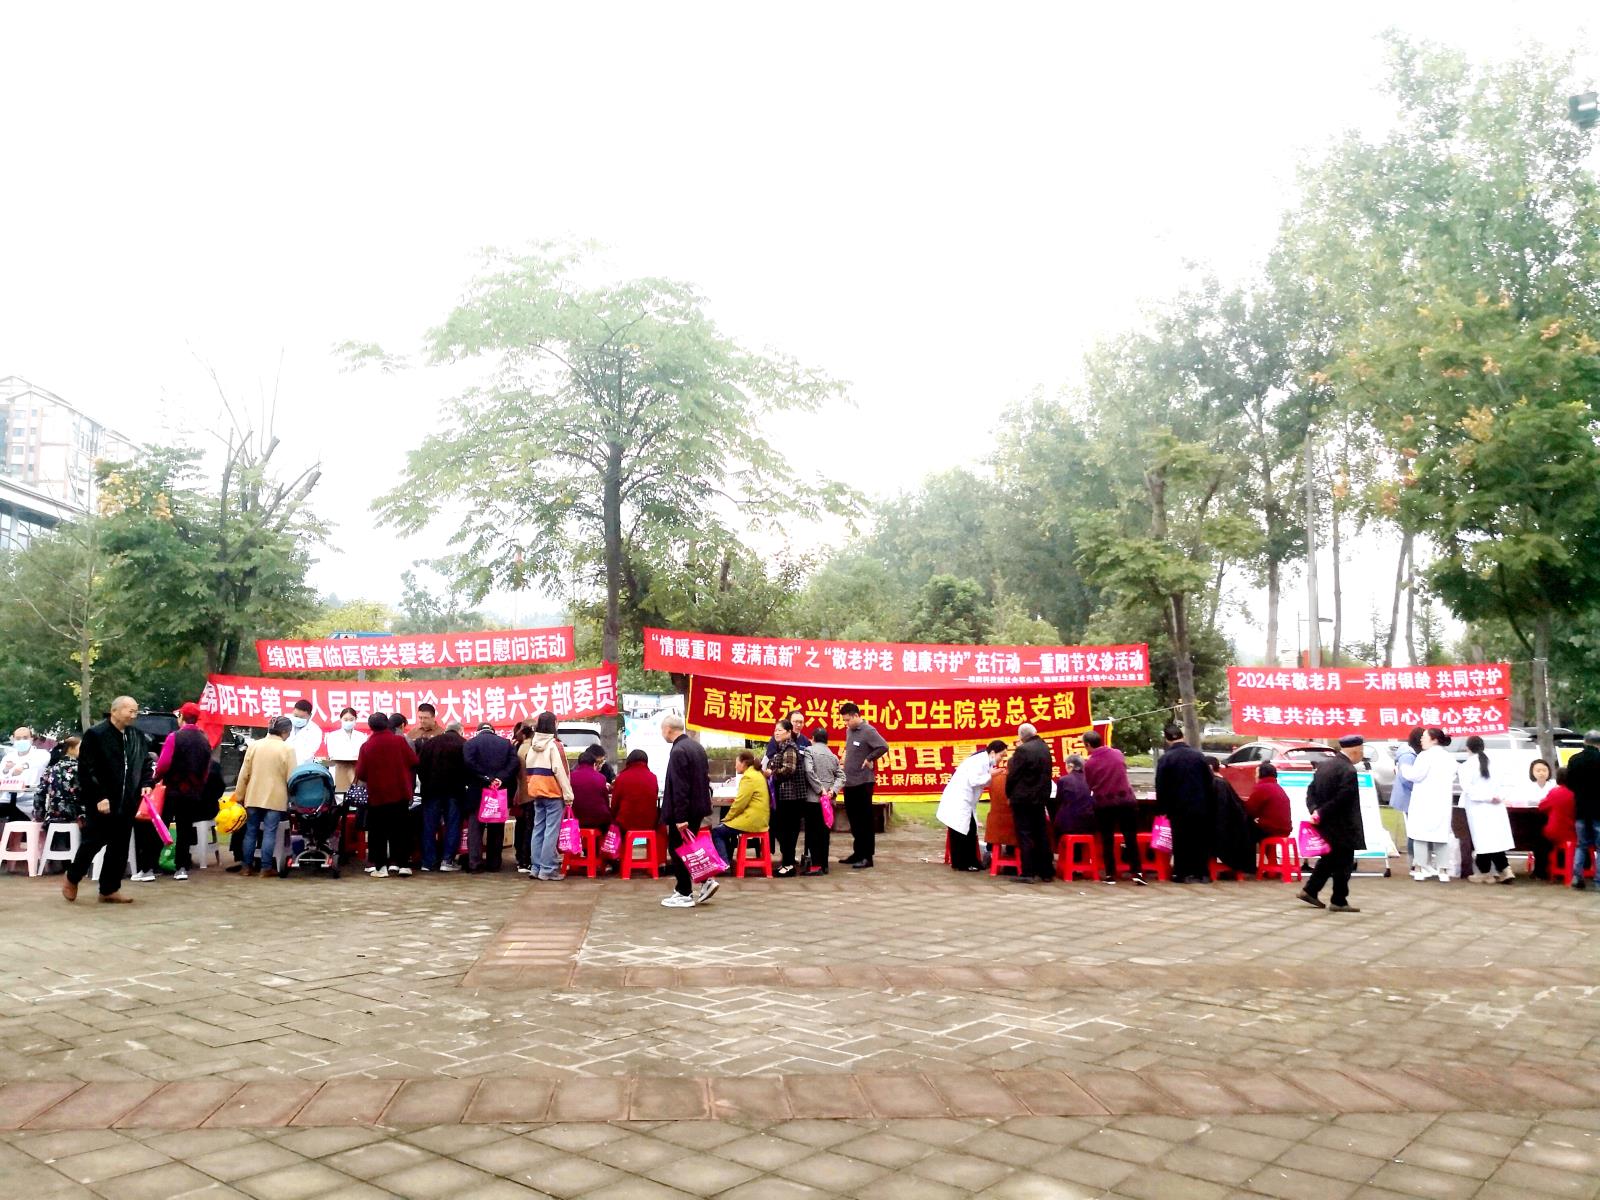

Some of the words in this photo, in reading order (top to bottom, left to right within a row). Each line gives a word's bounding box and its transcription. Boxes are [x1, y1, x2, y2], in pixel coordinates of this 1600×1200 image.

[267, 633, 566, 669] 绵阳富临医院关爱老人节日慰问活动
[1237, 671, 1341, 691] 2024年敬老月
[1436, 668, 1503, 689] 共同守护
[200, 674, 619, 725] 绵阳市第三人民医院门诊大科第六支部委员
[1242, 705, 1368, 727] 共建共治共享
[1380, 706, 1502, 727] 同心健心安心
